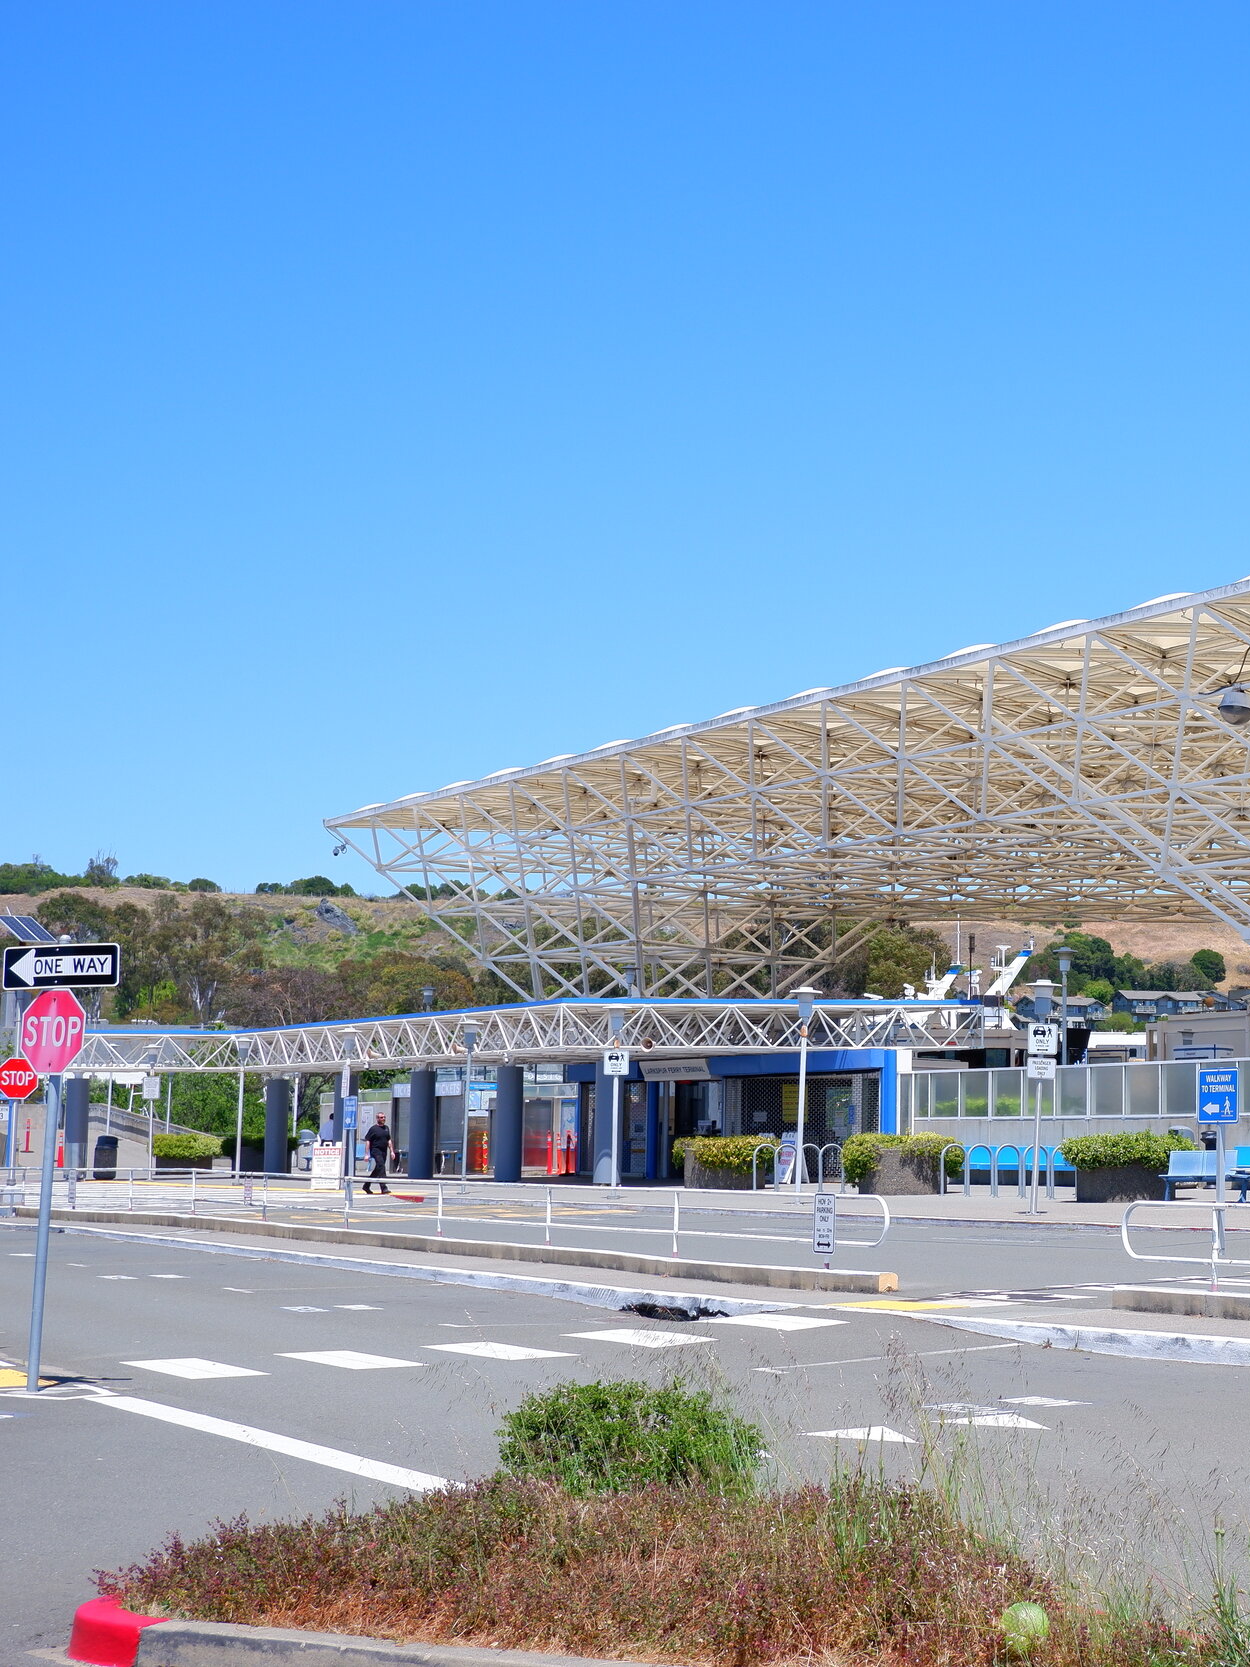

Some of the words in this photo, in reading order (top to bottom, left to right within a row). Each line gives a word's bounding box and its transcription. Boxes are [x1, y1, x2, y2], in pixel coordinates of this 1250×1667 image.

[34, 958, 63, 975] ONE
[73, 957, 109, 973] WAY
[24, 1016, 81, 1047] STOP
[1, 1071, 34, 1086] STOP
[1206, 1074, 1232, 1082] WALKWAY
[1209, 1084, 1235, 1092] TERMINAL
